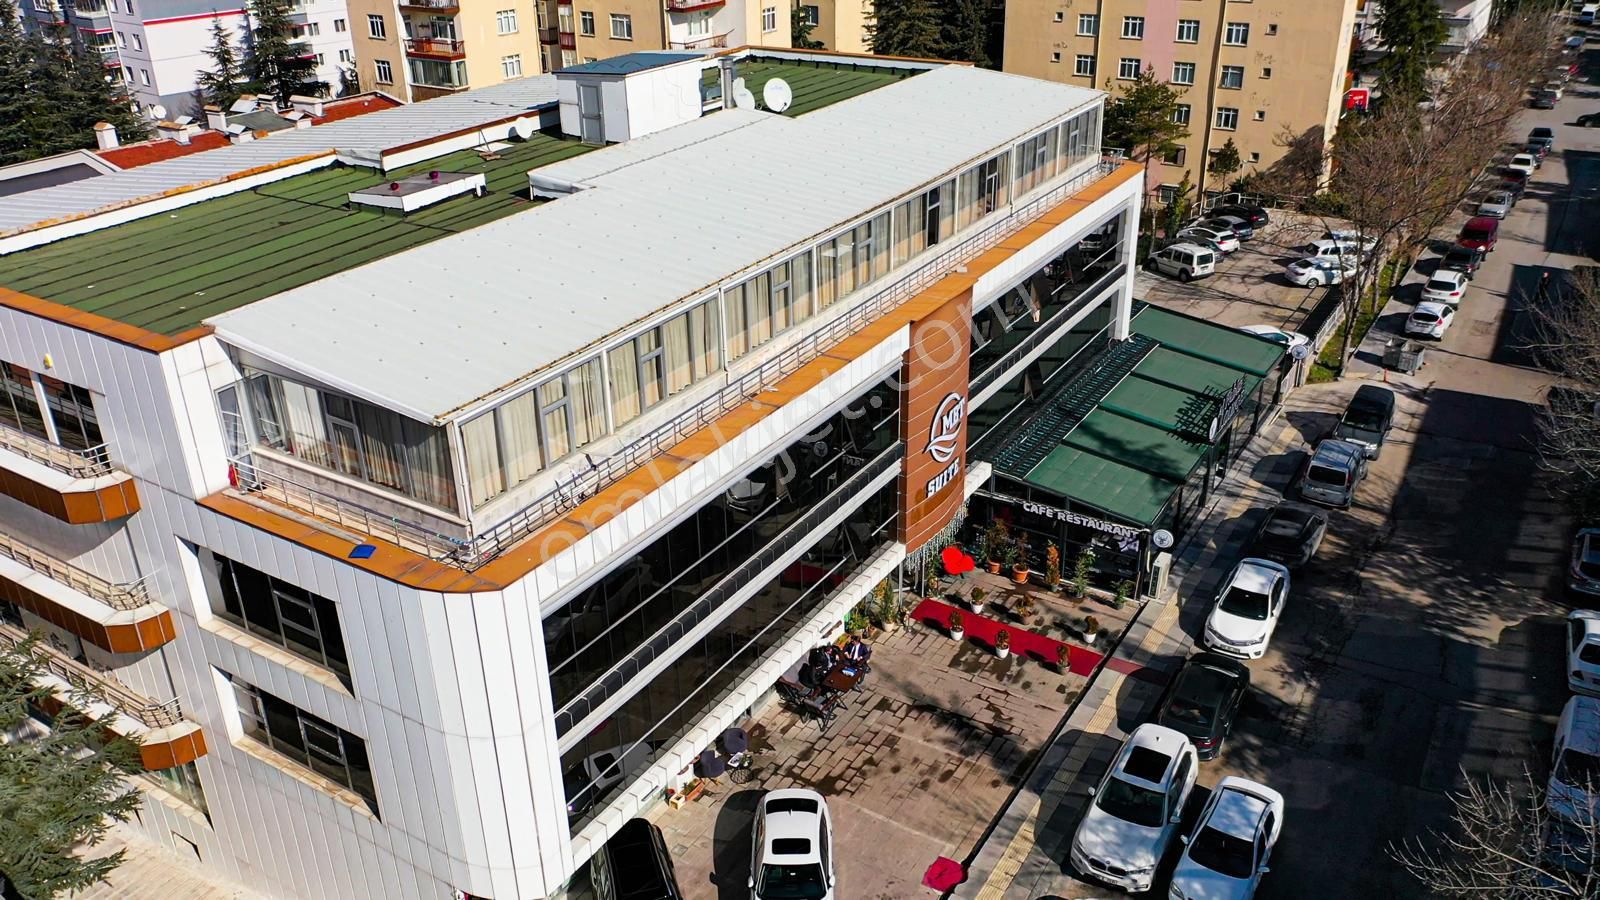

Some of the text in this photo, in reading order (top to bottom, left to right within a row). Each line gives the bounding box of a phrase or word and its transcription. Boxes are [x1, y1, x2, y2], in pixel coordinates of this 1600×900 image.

[942, 397, 965, 434] MBT
[927, 456, 960, 497] SUITE
[1023, 502, 1139, 538] CAFE RESTAURANT
